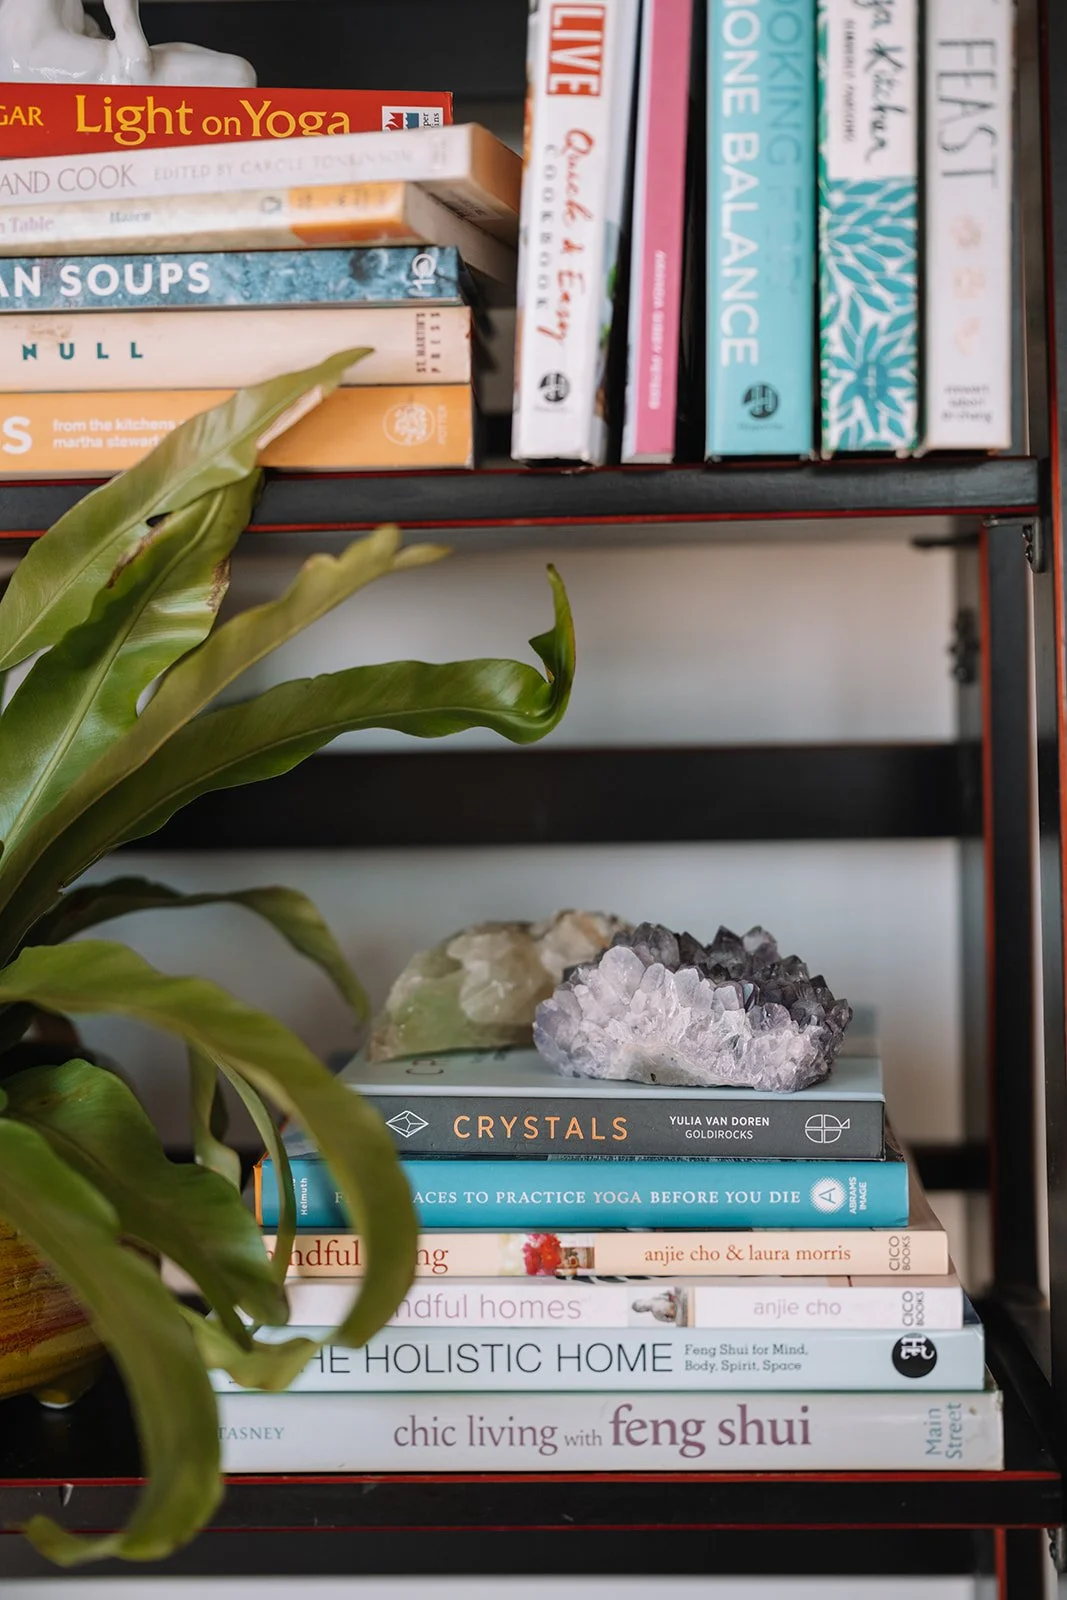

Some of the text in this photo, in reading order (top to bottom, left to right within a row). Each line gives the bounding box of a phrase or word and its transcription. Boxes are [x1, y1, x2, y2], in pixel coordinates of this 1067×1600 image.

[549, 8, 603, 94] LIVE
[766, 0, 804, 166] OKING
[76, 95, 350, 146] Light on Yoga
[936, 37, 998, 190] FEAST
[0, 164, 135, 195] AND COOK
[562, 128, 595, 227] Quick
[720, 0, 760, 367] ONE BALANCE
[536, 143, 558, 309] COOKBOOK
[60, 262, 211, 297] SOUPS
[536, 269, 586, 345] Easy
[23, 342, 143, 360] NULL
[2, 416, 32, 454] S
[53, 419, 176, 431] from the kitchens
[53, 437, 103, 448] martha
[454, 1116, 627, 1140] CRYSTALS
[670, 1116, 769, 1126] YULIA VAN DOREN
[686, 1130, 753, 1139] GOLDIROCKS
[300, 1177, 308, 1216] Helmuth
[413, 1191, 800, 1204] ACES TO PRACTICE YOGA BEFORE YOU DIE
[849, 1177, 857, 1213] ABRAMS
[859, 1182, 867, 1209] IMAGE
[287, 1240, 361, 1266] ndful
[645, 1245, 850, 1265] anjie cho & laura morris
[889, 1236, 900, 1271] CICO
[902, 1236, 911, 1271] BOOKS
[396, 1293, 581, 1319] ndful homes
[754, 1299, 841, 1319] anjie cho
[902, 1291, 914, 1326] CICO
[916, 1291, 925, 1326] BOOKS
[306, 1343, 672, 1373] HE HOLISTIC HOME
[685, 1344, 807, 1357] Feng Shui for Mind,
[685, 1360, 801, 1373] Body, Spirit, Space
[216, 1427, 284, 1440] TASNEY
[394, 1404, 811, 1458] chic living with feng shui
[924, 1409, 942, 1455] Main
[945, 1403, 962, 1459] Street
